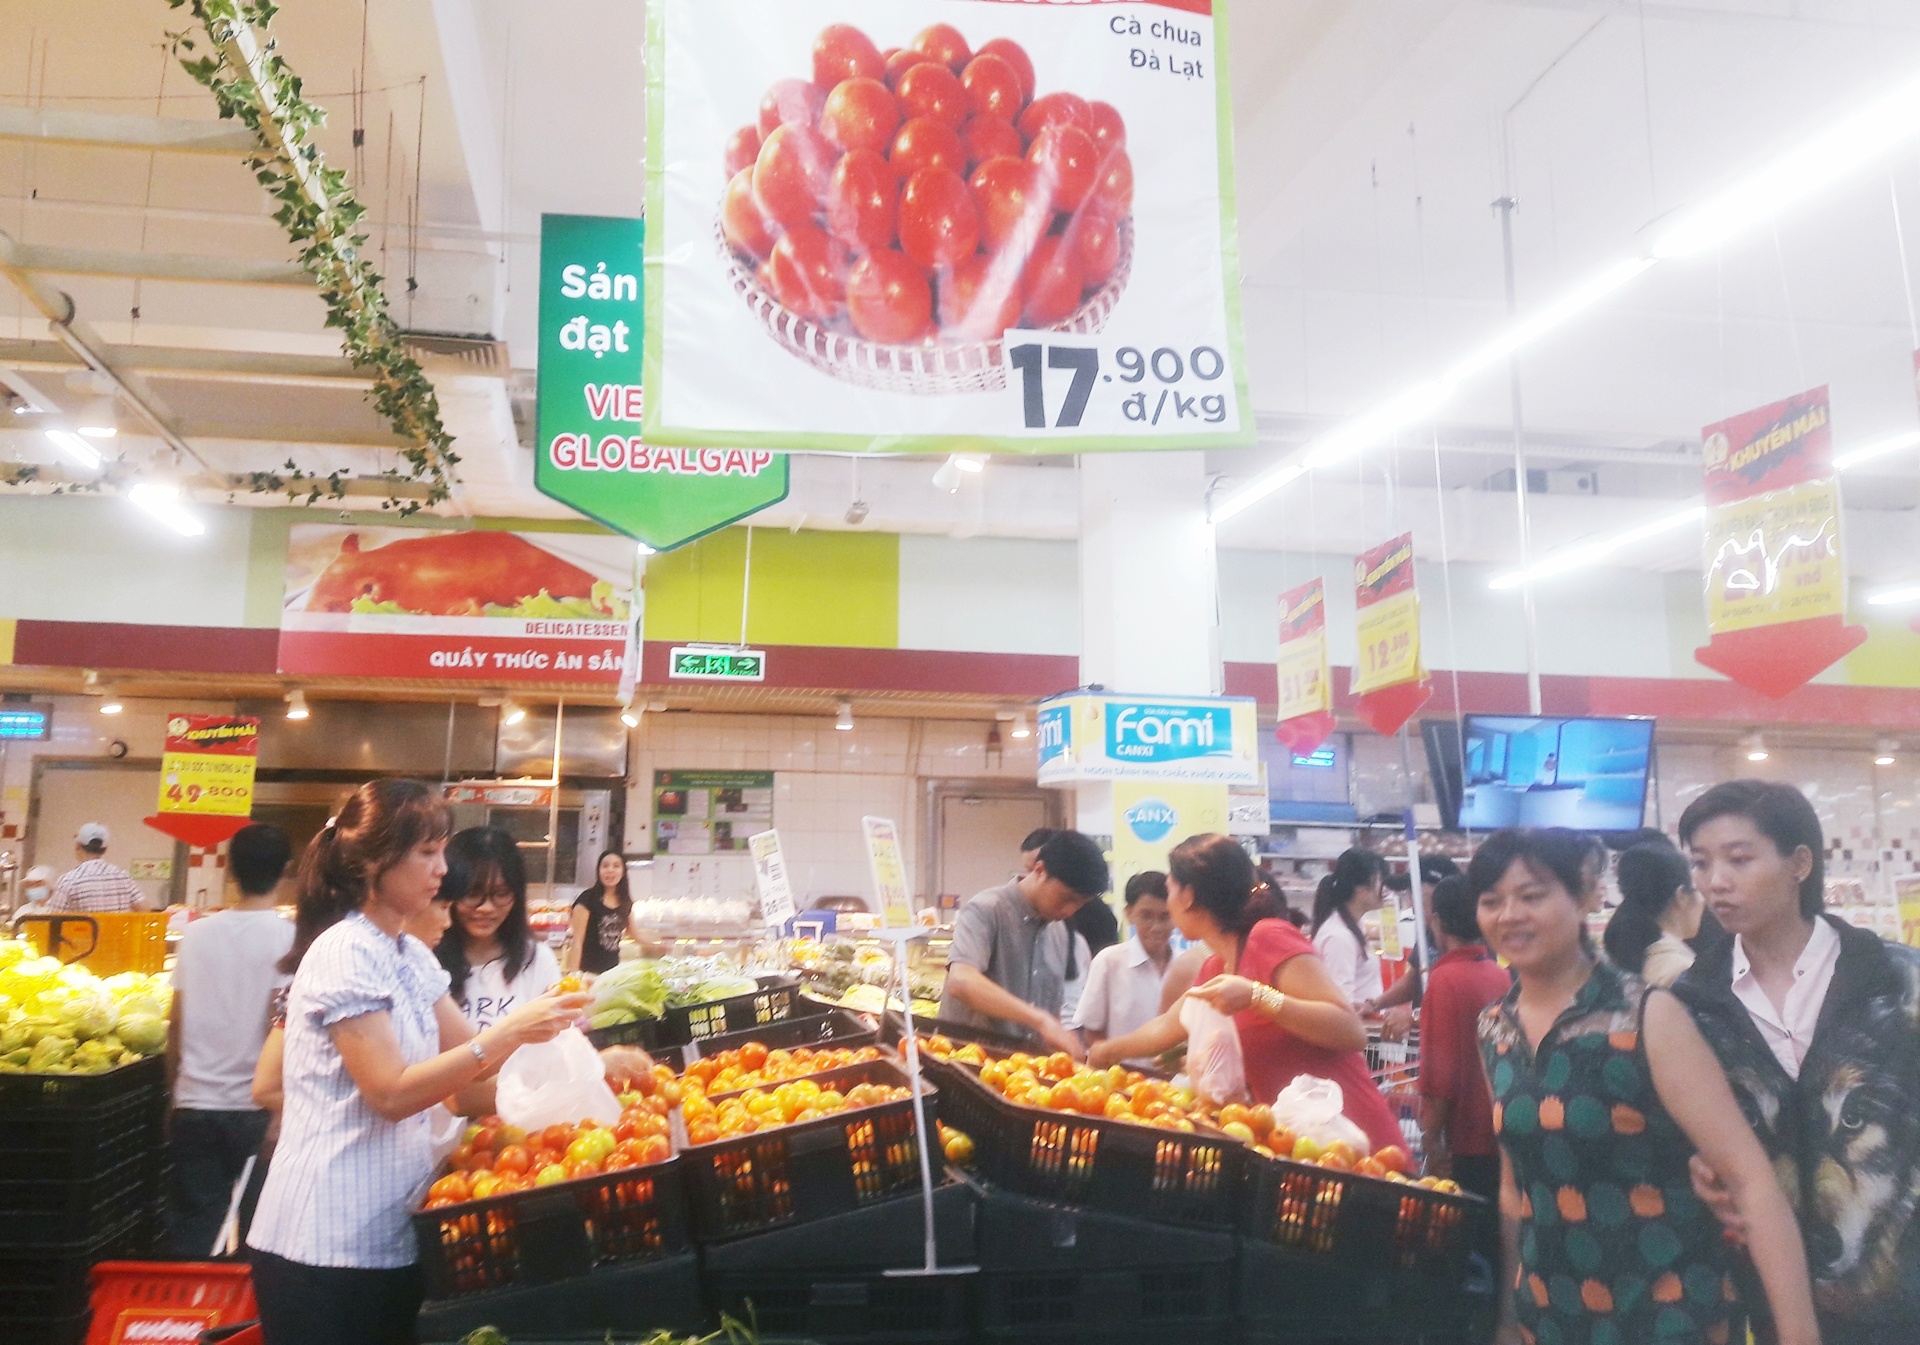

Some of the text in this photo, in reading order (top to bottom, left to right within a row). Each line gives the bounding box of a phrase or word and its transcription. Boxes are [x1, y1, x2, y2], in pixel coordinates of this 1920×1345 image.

[1110, 15, 1202, 47] Cà chua
[1129, 48, 1204, 80] Đà Lạt
[560, 261, 637, 301] Sản
[559, 315, 629, 358] đạt
[1122, 389, 1226, 423] đ/kg
[551, 434, 772, 476] GLOBALGAP
[526, 622, 628, 637] DELICATESSEN
[493, 649, 549, 669] THỨC
[554, 650, 583, 670] ĂN
[1116, 706, 1214, 747] Fami
[1116, 745, 1154, 757] CANXI
